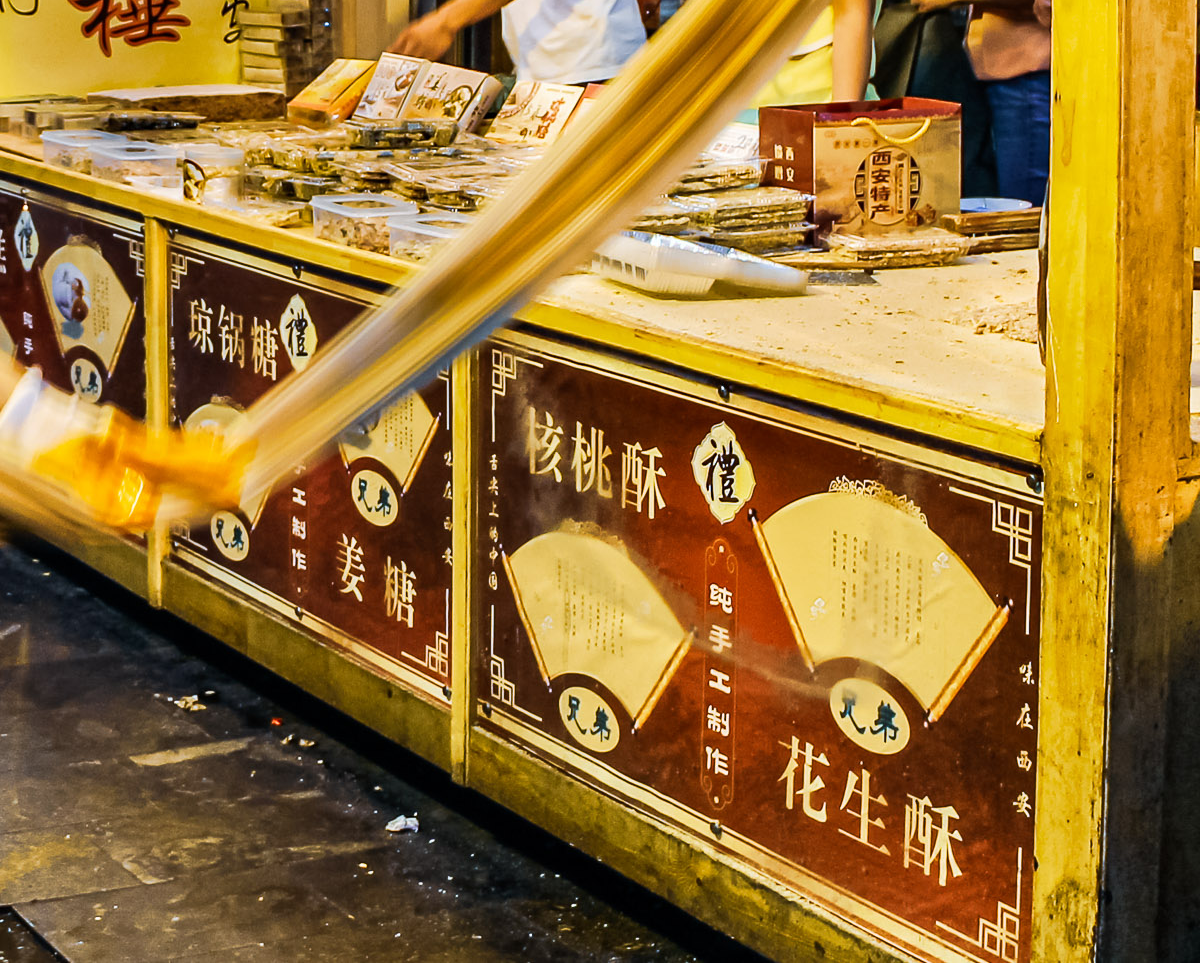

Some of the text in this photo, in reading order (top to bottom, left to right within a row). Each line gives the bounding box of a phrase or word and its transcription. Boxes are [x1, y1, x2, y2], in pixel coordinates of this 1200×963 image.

[870, 150, 892, 220] 西安特产
[188, 298, 279, 381] 琼锅糖
[357, 477, 392, 518] 兄弟
[524, 406, 669, 520] 核桃酥
[701, 439, 741, 504] 禮
[215, 518, 246, 554] 兄弟
[488, 453, 500, 592] 舌尖上的中国
[336, 532, 418, 629] 姜糖
[566, 694, 612, 743] 兄弟
[705, 582, 735, 776] 纯手工制作
[840, 688, 900, 744] 兄弟
[1012, 660, 1036, 818] 味在西安
[777, 735, 965, 887] 花生酥
